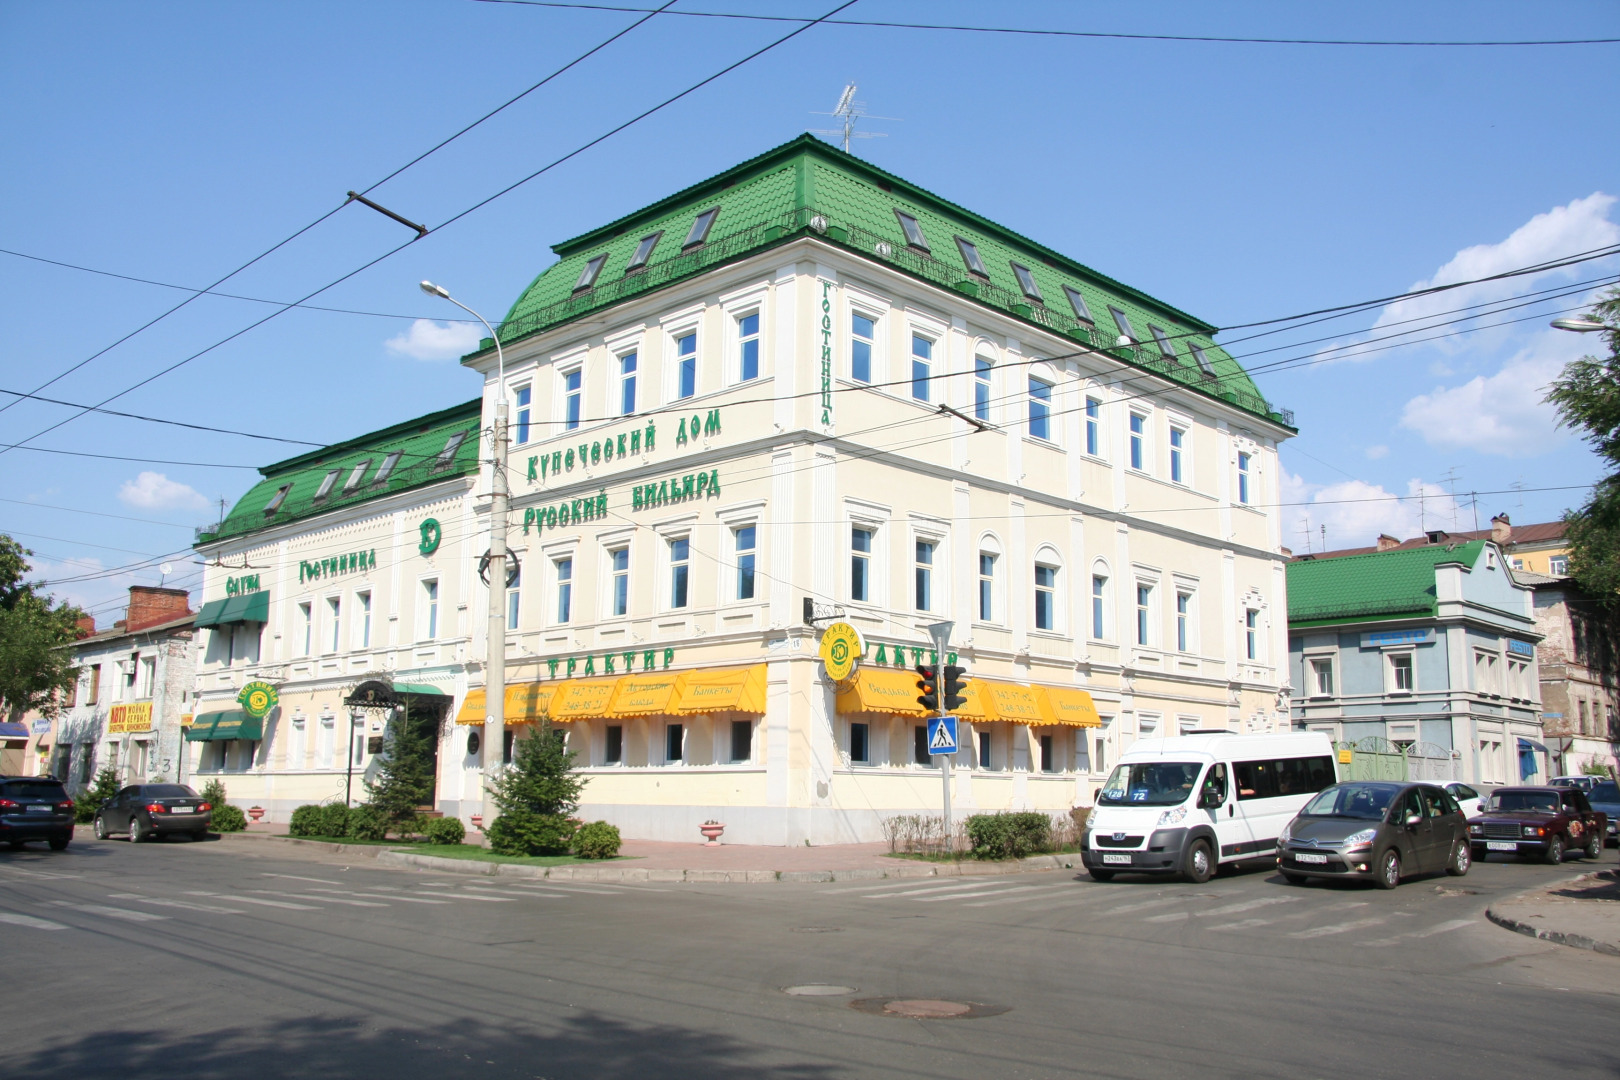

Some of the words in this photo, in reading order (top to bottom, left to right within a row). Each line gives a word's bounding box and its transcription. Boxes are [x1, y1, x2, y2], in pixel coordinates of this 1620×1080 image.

[821, 282, 832, 426] ГОСТИНИЦА
[527, 419, 656, 481] КУПЕЧЕСКИЙ
[676, 409, 721, 444] ДОМ
[523, 488, 608, 533] РУССКИЙ
[632, 469, 721, 507] БИЛЬЯРД
[822, 624, 858, 647] ТРАКТИР
[1369, 630, 1426, 645] FESTO
[1510, 640, 1531, 654] FESTO
[547, 648, 674, 678] ТРАКТИР
[239, 681, 278, 702] ГОСТИНИЦА
[693, 685, 732, 696] Банкеты
[869, 683, 910, 697] Свадьбы
[128, 704, 145, 713] МОЙКА
[1059, 700, 1091, 713] Банкеты
[111, 706, 126, 723] АВТО
[127, 714, 147, 723] СЕРВИС
[1108, 790, 1123, 798] 128
[1133, 792, 1146, 801] 72
